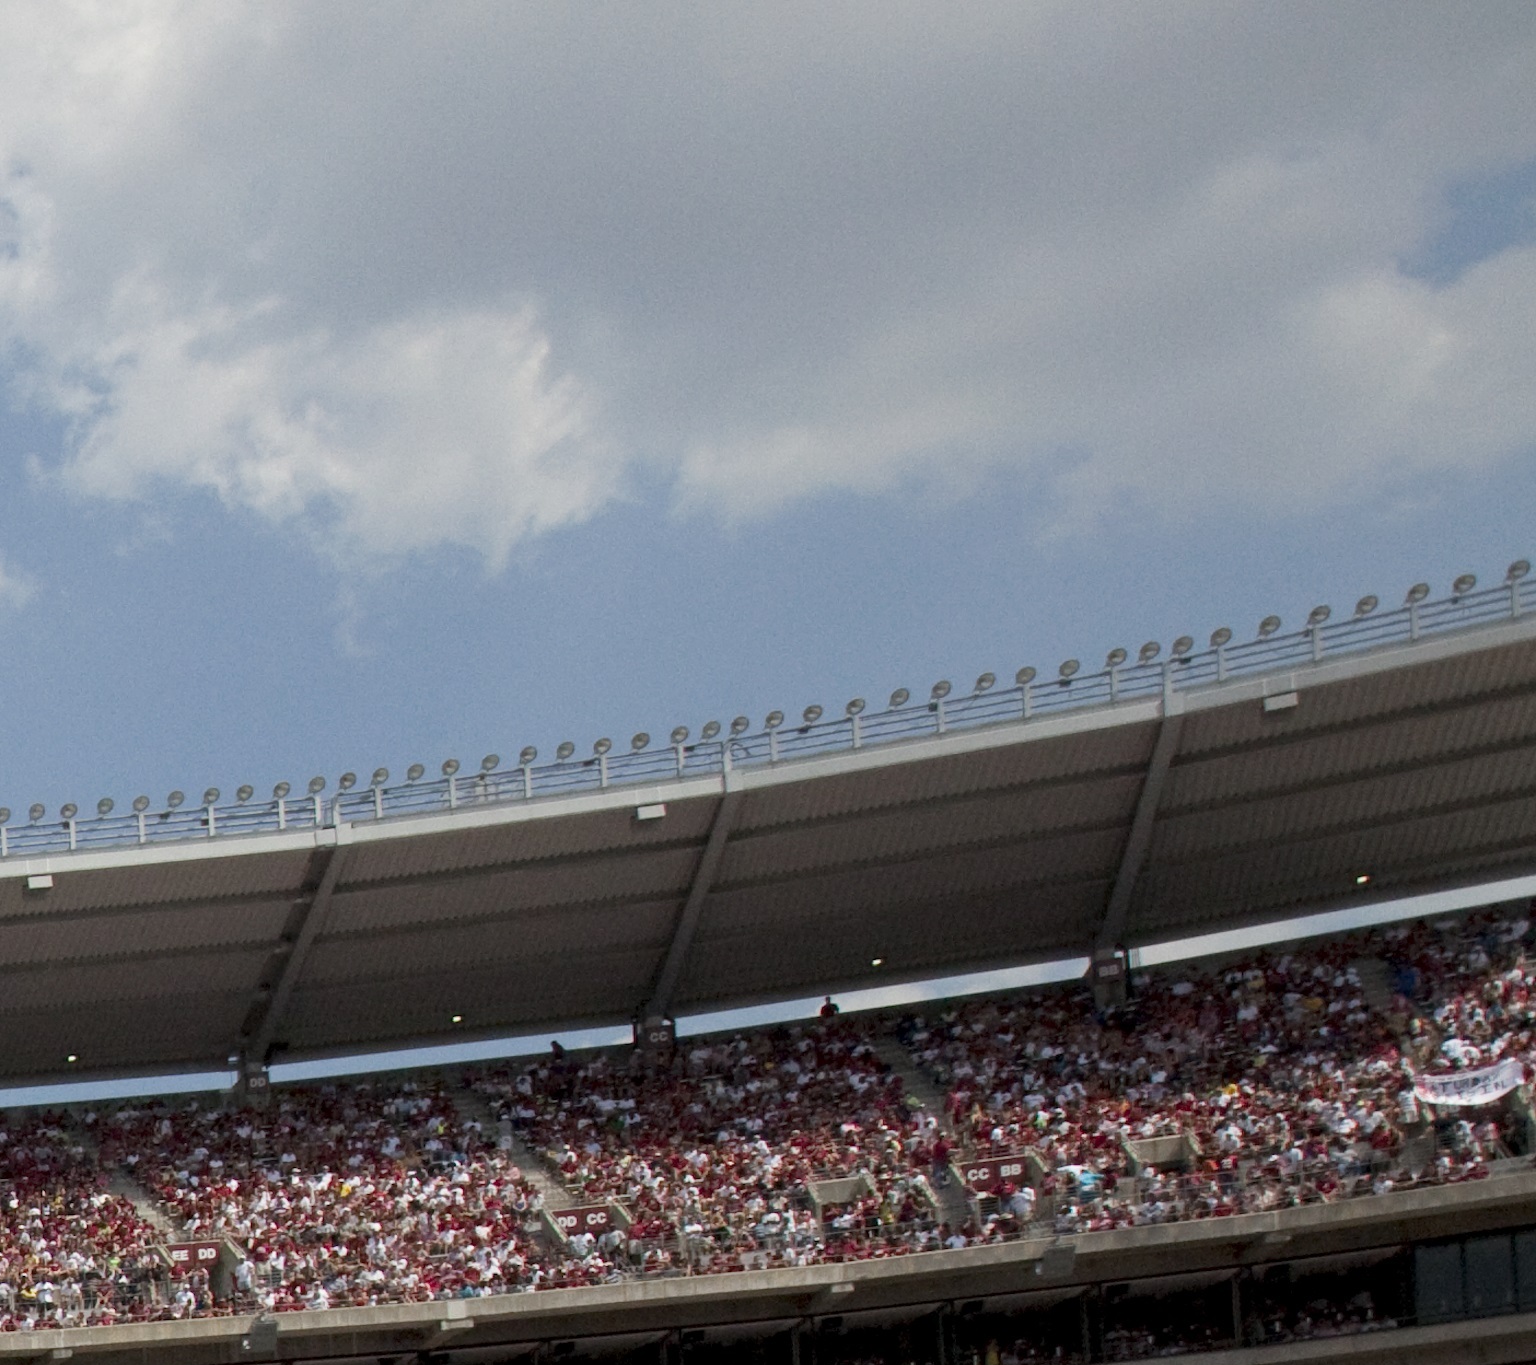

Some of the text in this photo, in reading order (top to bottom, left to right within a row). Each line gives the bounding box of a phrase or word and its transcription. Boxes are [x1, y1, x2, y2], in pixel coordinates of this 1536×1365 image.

[967, 1168, 990, 1181] CC
[587, 1212, 607, 1224] CC
[198, 1248, 217, 1259] DD
